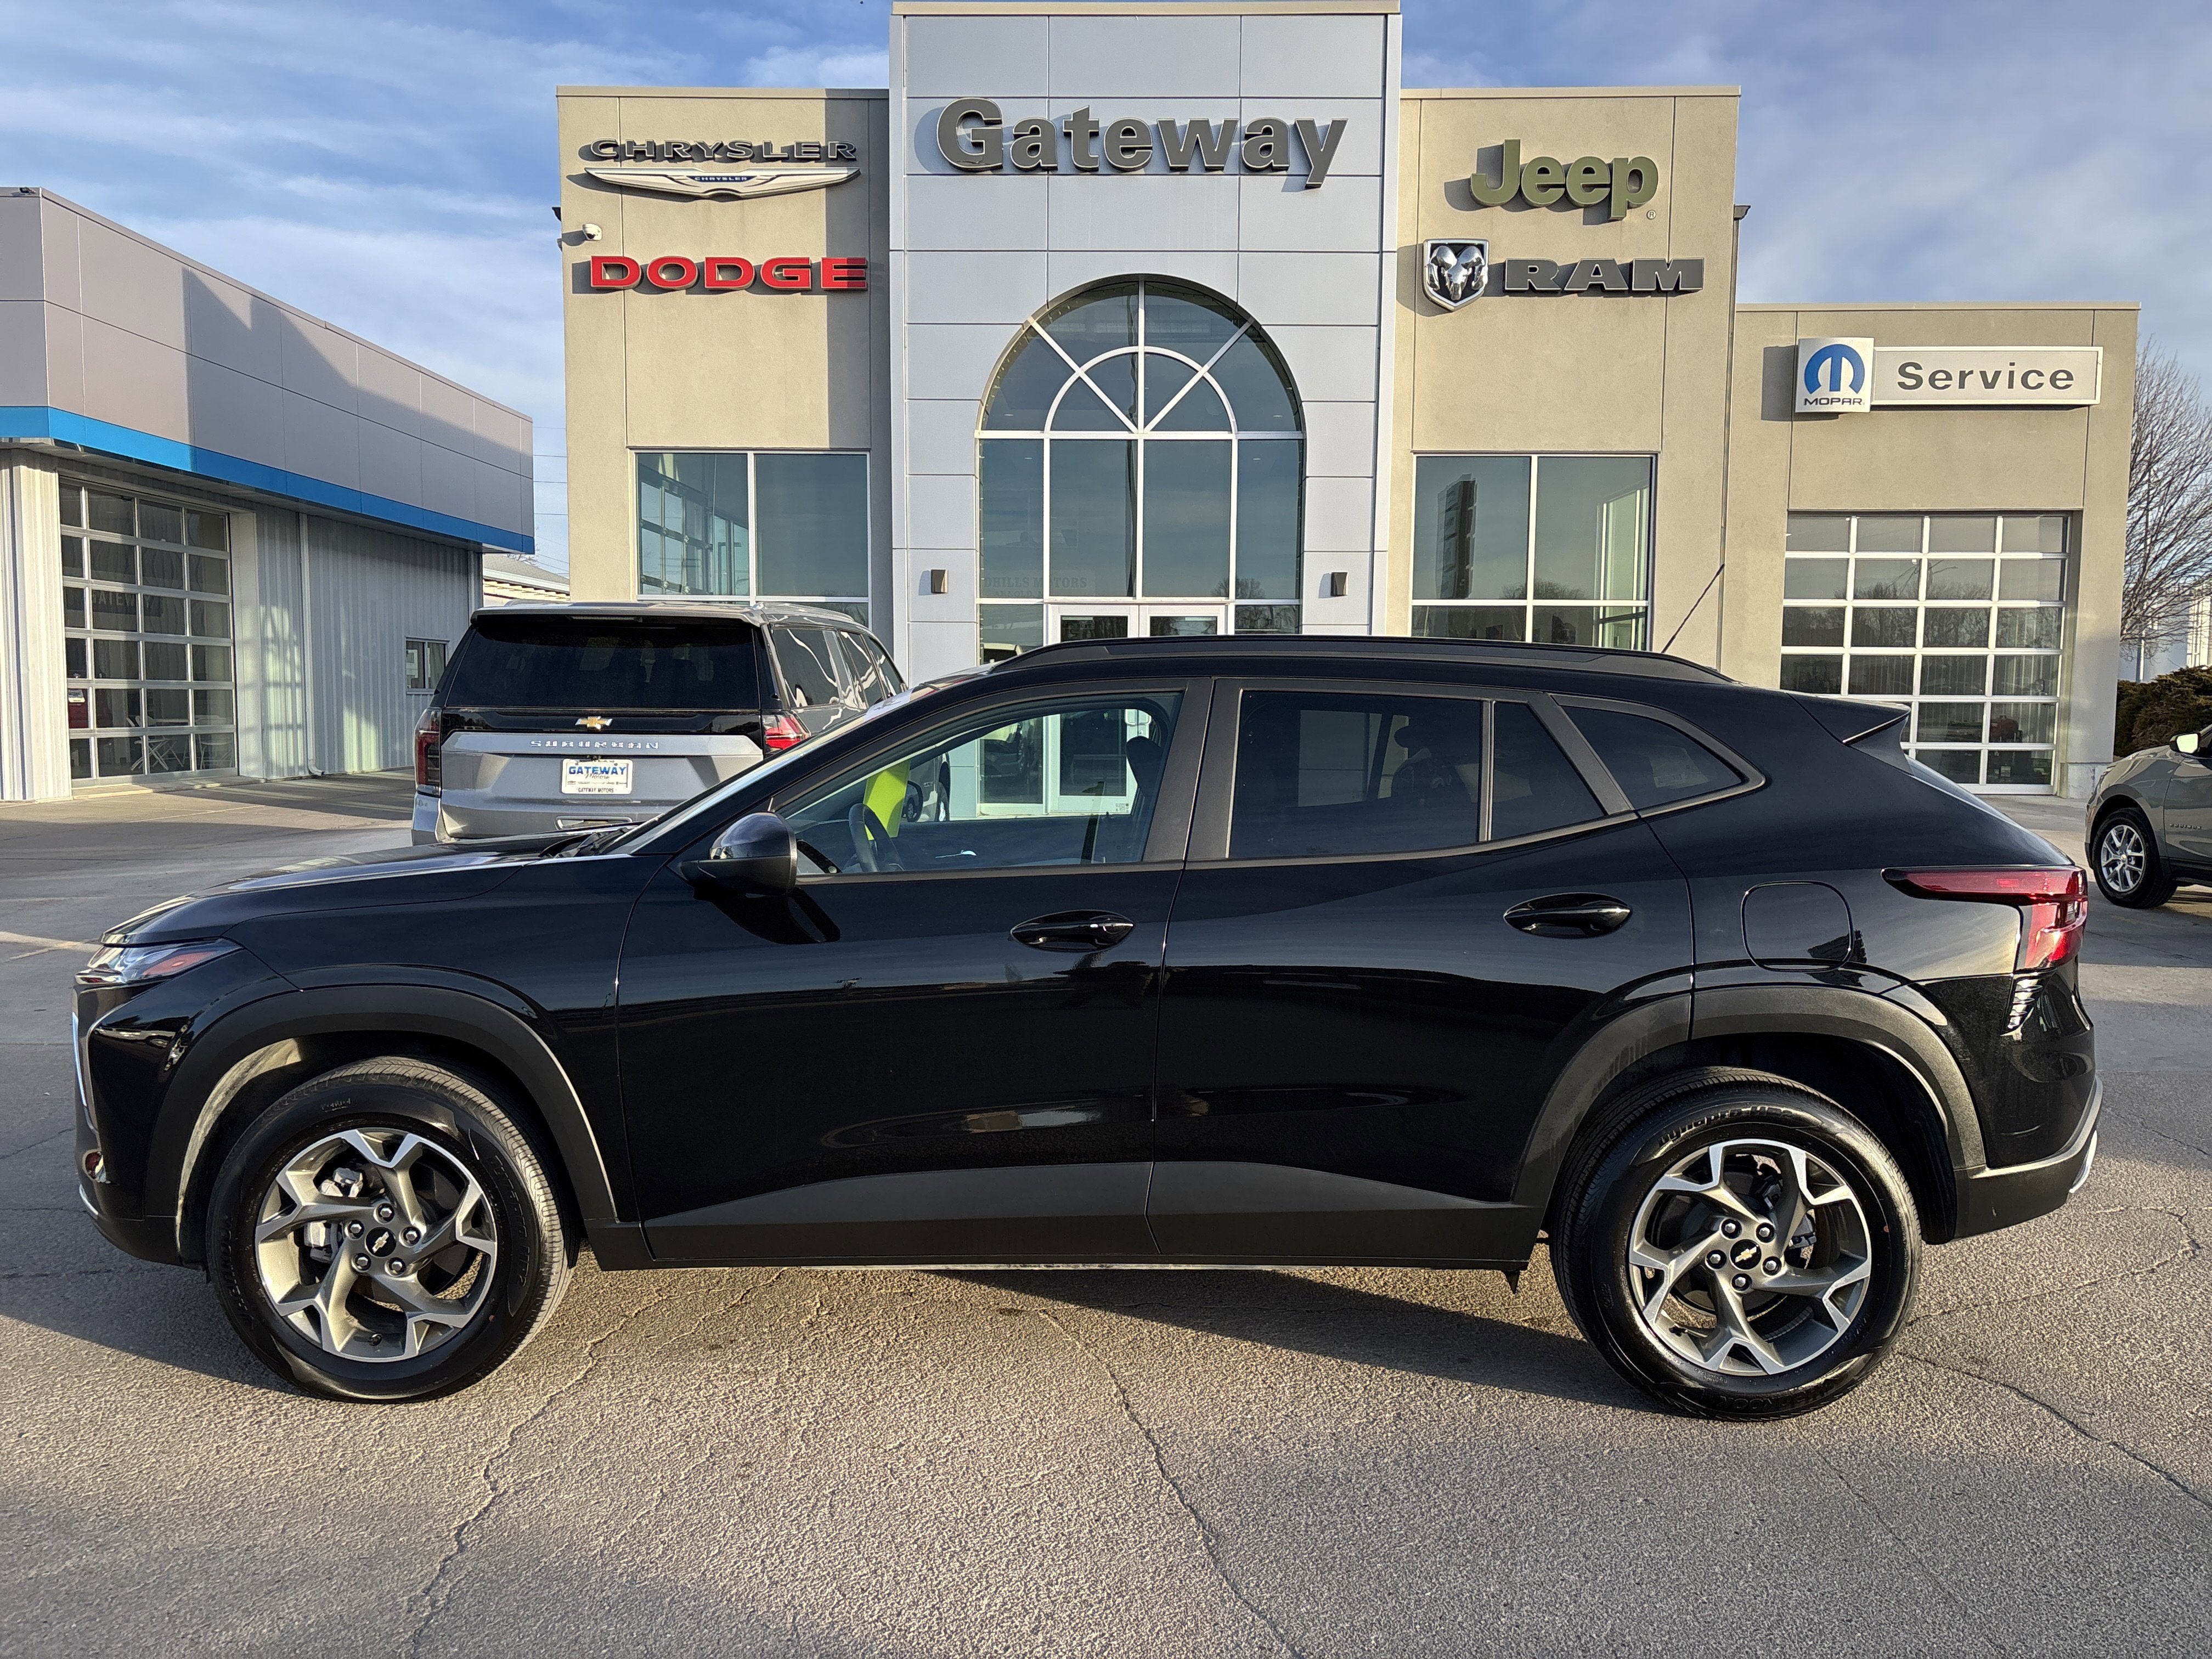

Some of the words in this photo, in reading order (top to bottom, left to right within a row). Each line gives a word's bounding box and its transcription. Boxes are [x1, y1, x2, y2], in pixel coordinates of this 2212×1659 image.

[590, 138, 857, 161] CHRYSLER
[936, 97, 1348, 189] Gateway
[1470, 139, 1659, 220] Jeep
[590, 255, 867, 291] DODGE
[1504, 257, 1705, 292] RAM
[1897, 361, 2075, 391] Service
[1803, 397, 1863, 405] MOPAR
[1033, 577, 1087, 588] MTORS
[530, 740, 659, 749] SUBURBAN
[568, 766, 627, 775] GATEWAY
